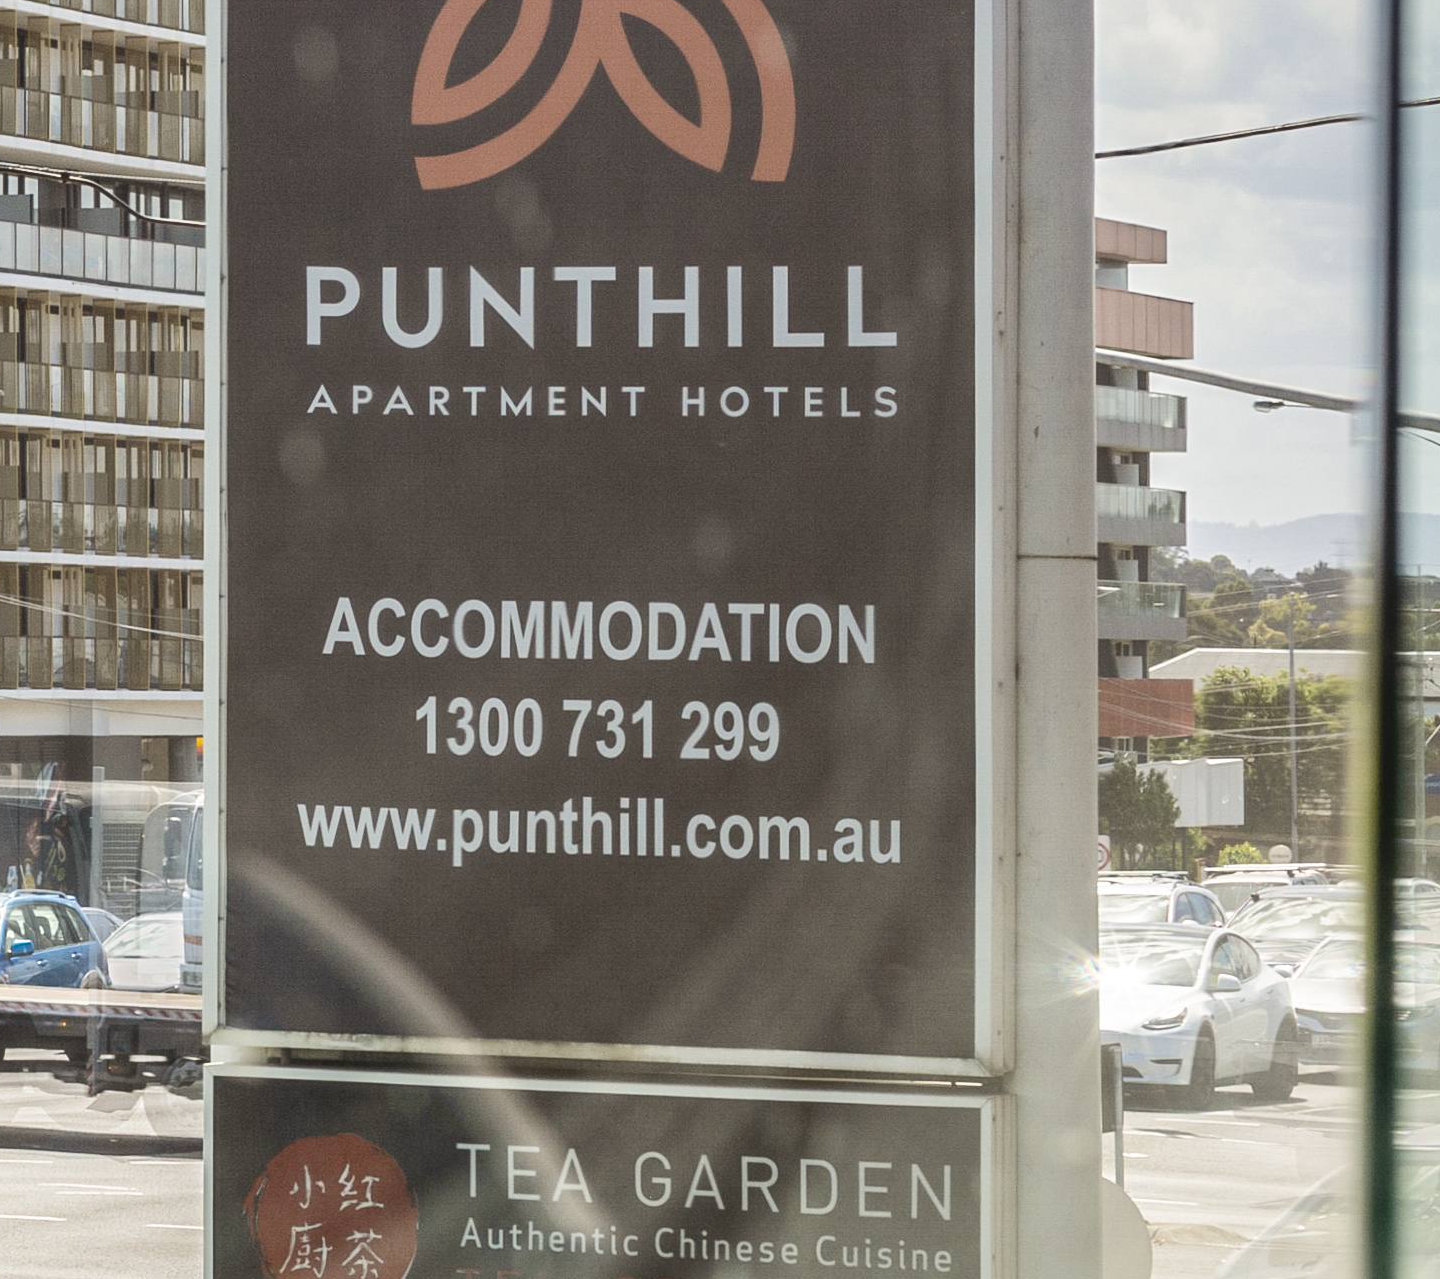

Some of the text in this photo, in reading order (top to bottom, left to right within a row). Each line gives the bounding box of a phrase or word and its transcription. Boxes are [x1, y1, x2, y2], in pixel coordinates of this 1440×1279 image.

[305, 264, 898, 350] PUNTHILL
[306, 384, 899, 418] APARTMENT HOTELS
[322, 596, 877, 665] ACCOMMODATION
[414, 696, 781, 762] 1300 731 299
[296, 796, 902, 867] www.punthill.com.au
[455, 1142, 952, 1221] TEA GARDEN
[459, 1217, 953, 1273] Authentic Chinese Cuisine
